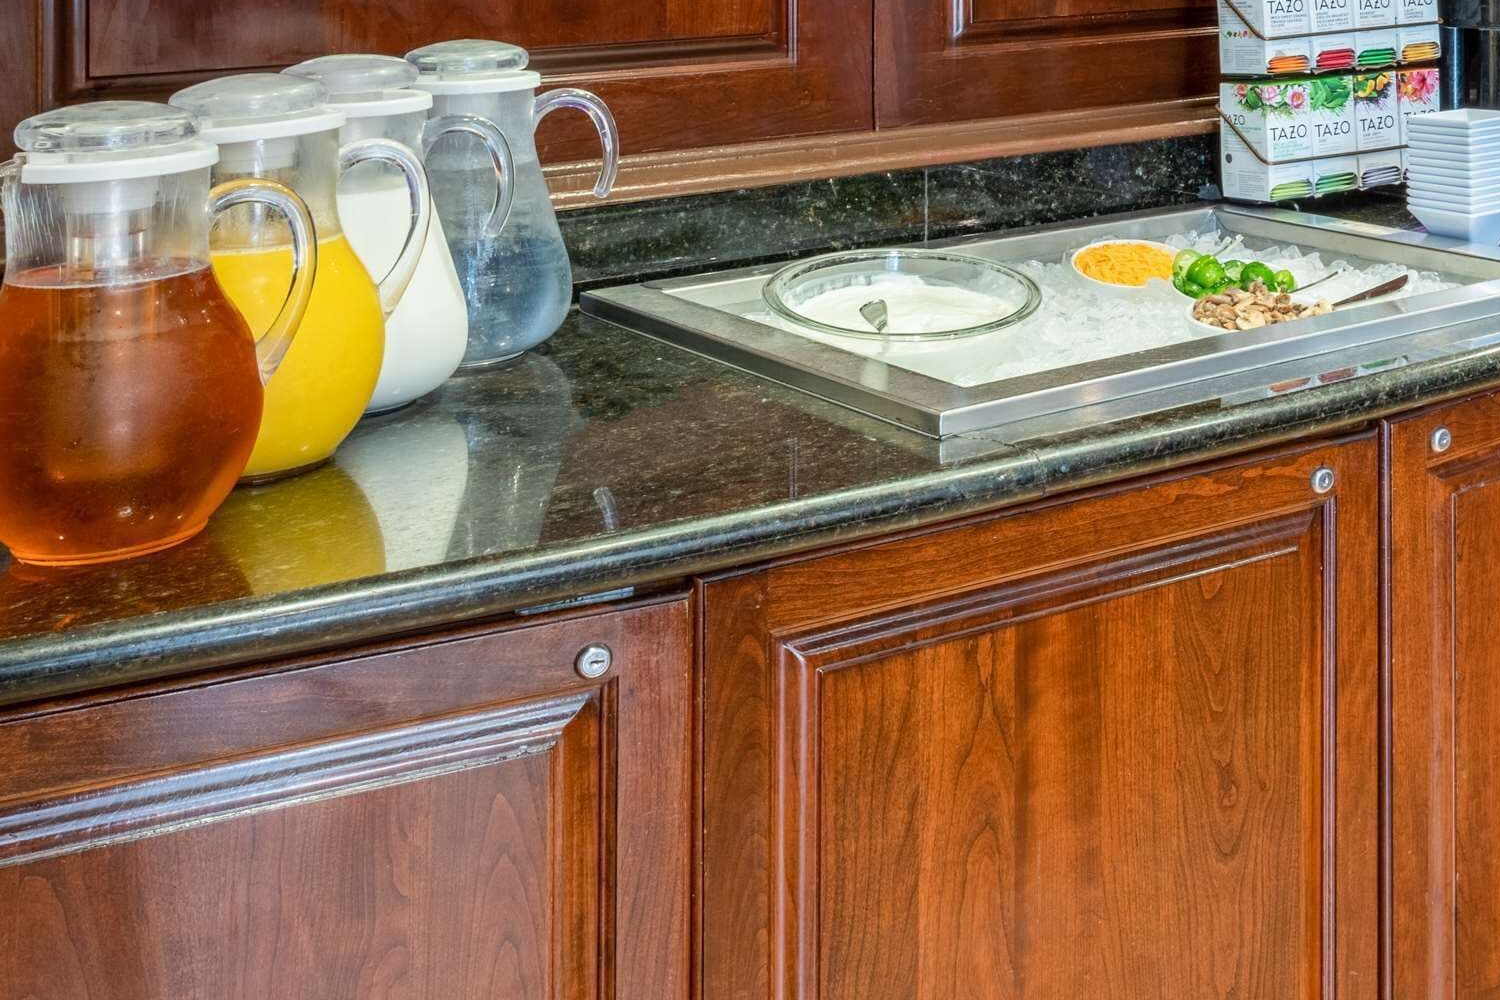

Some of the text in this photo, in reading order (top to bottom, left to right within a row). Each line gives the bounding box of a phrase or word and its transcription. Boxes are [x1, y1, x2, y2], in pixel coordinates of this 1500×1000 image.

[1267, 0, 1304, 15] TAZO
[1314, 120, 1351, 138] TAZO
[1359, 114, 1394, 132] TAZO
[1270, 124, 1308, 141] TAZO
